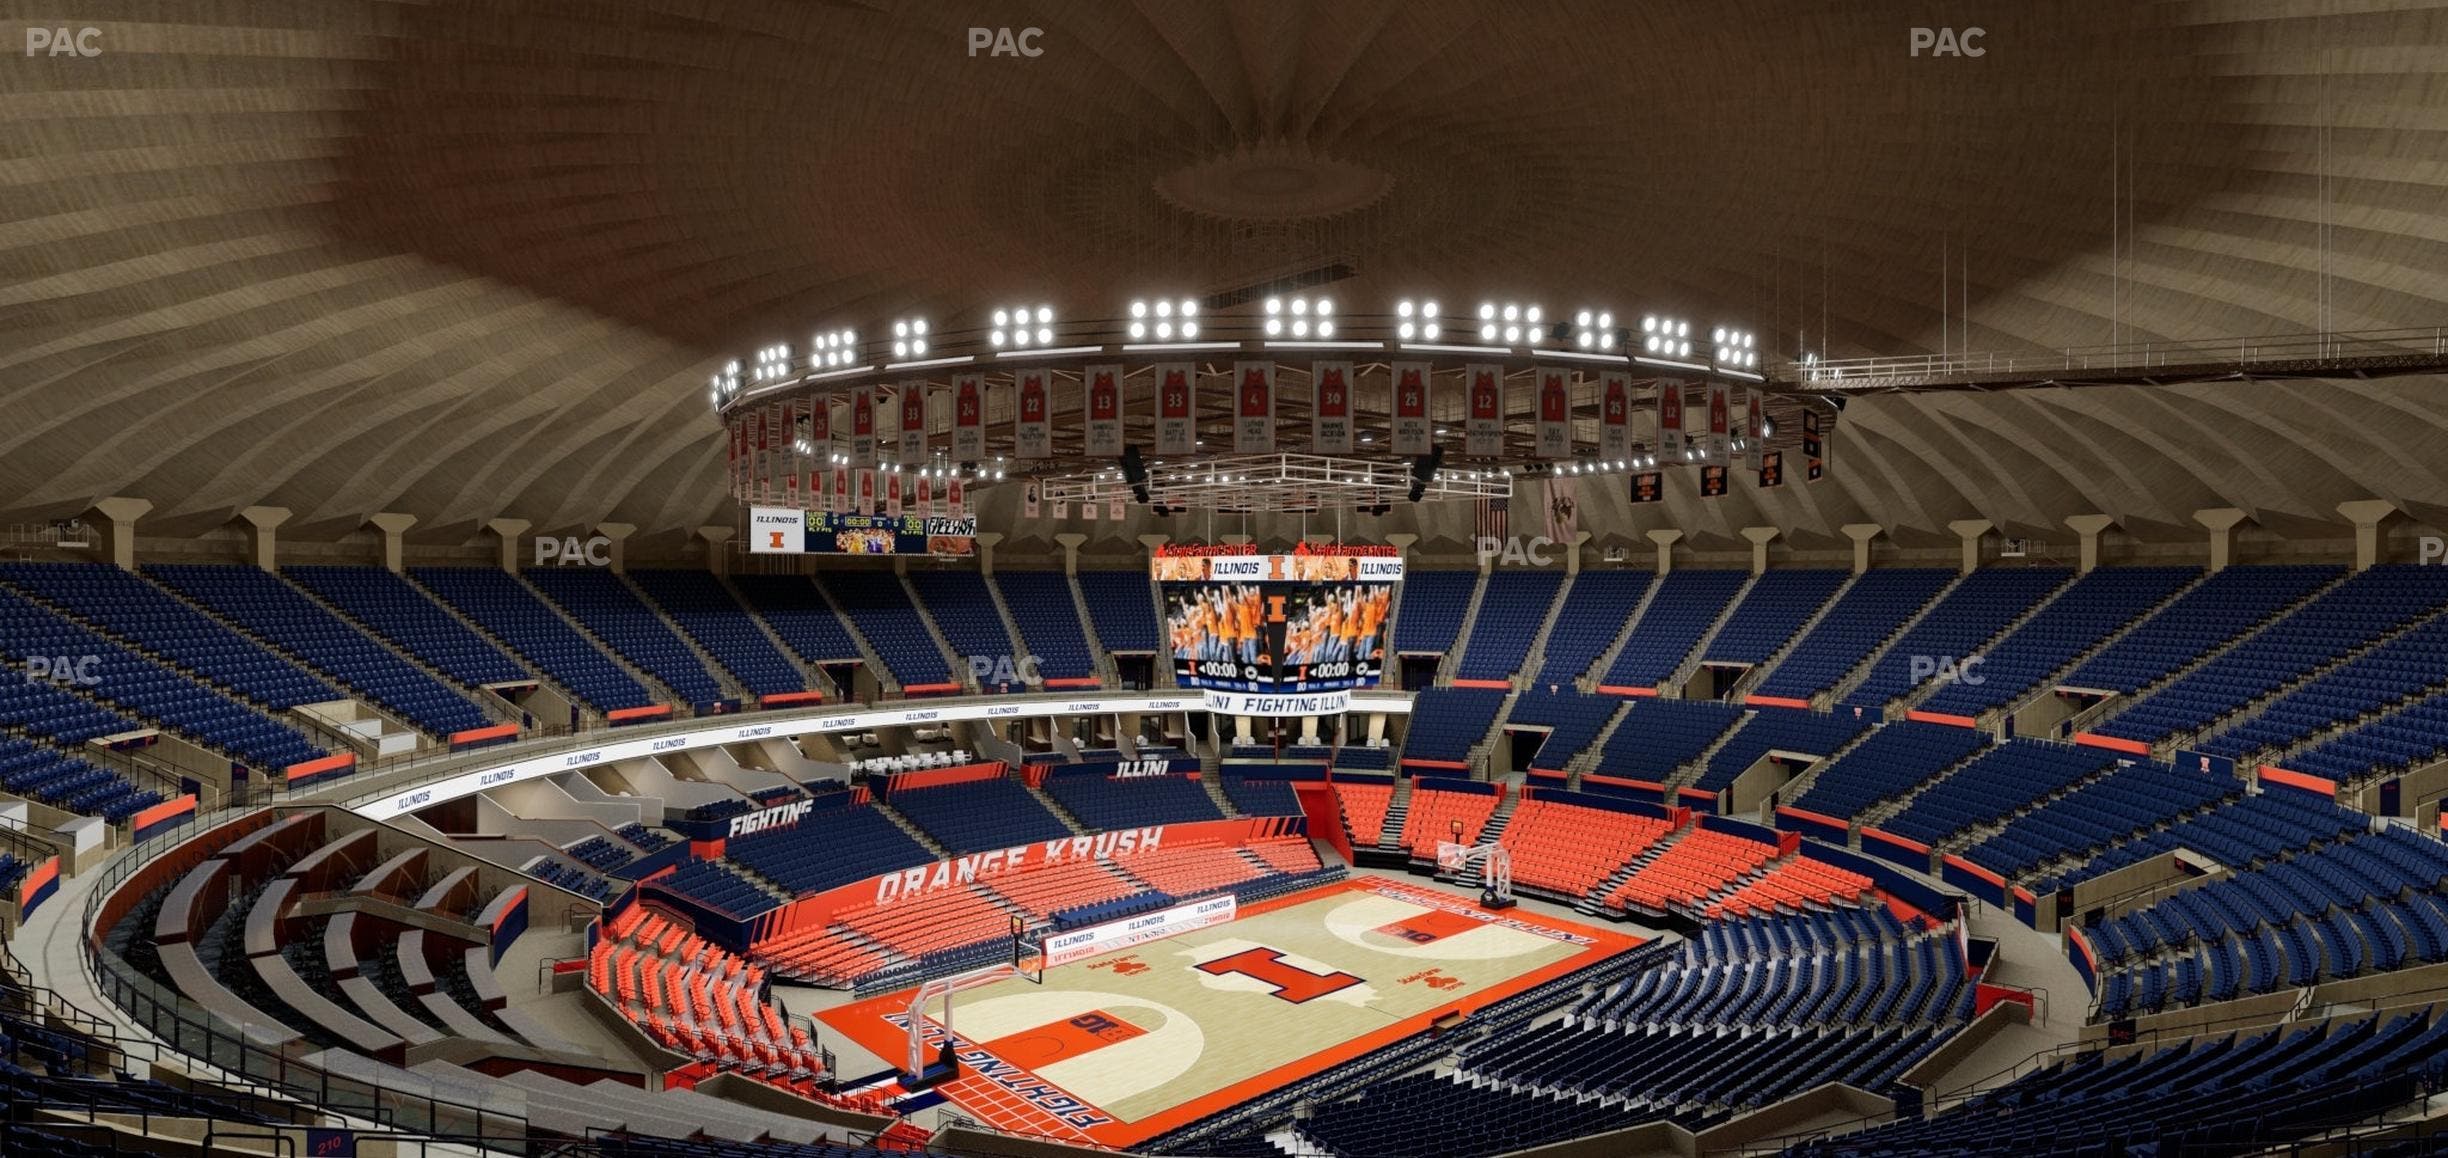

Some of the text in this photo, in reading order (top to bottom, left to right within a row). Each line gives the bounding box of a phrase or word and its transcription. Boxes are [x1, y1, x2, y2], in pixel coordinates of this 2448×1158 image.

[1168, 393, 1183, 407] 33
[1326, 393, 1341, 405] 30
[1478, 395, 1492, 409] 12
[756, 515, 799, 524] ILLINOIS
[808, 516, 823, 526] 00
[1213, 562, 1260, 575] ILLINOIS
[1360, 563, 1402, 575] ILLINOIS
[1206, 661, 1237, 678] 00:00
[1318, 662, 1349, 678] 00:00
[987, 706, 1020, 715] ILLINOIS
[1068, 703, 1100, 711] ILLINOIS
[1148, 701, 1180, 709] ILLINOIS
[1244, 699, 1317, 712] FIGHTING
[905, 711, 938, 721] ILLINOIS
[822, 718, 855, 728] ILLINOIS
[737, 727, 772, 738] ILLINOIS
[652, 738, 686, 751] ILLINOIS
[566, 752, 601, 766] ILLINOIS
[1116, 760, 1169, 778] ILLINI
[479, 769, 515, 786] ILLINOIS
[397, 790, 431, 811] ILLINOIS
[876, 826, 1164, 906] ORANGE KRUSH
[1197, 899, 1231, 914] ILLINOIS
[1128, 915, 1165, 930] ILLINOIS
[1054, 932, 1095, 948] ILLINOIS
[318, 1135, 342, 1155] 210
